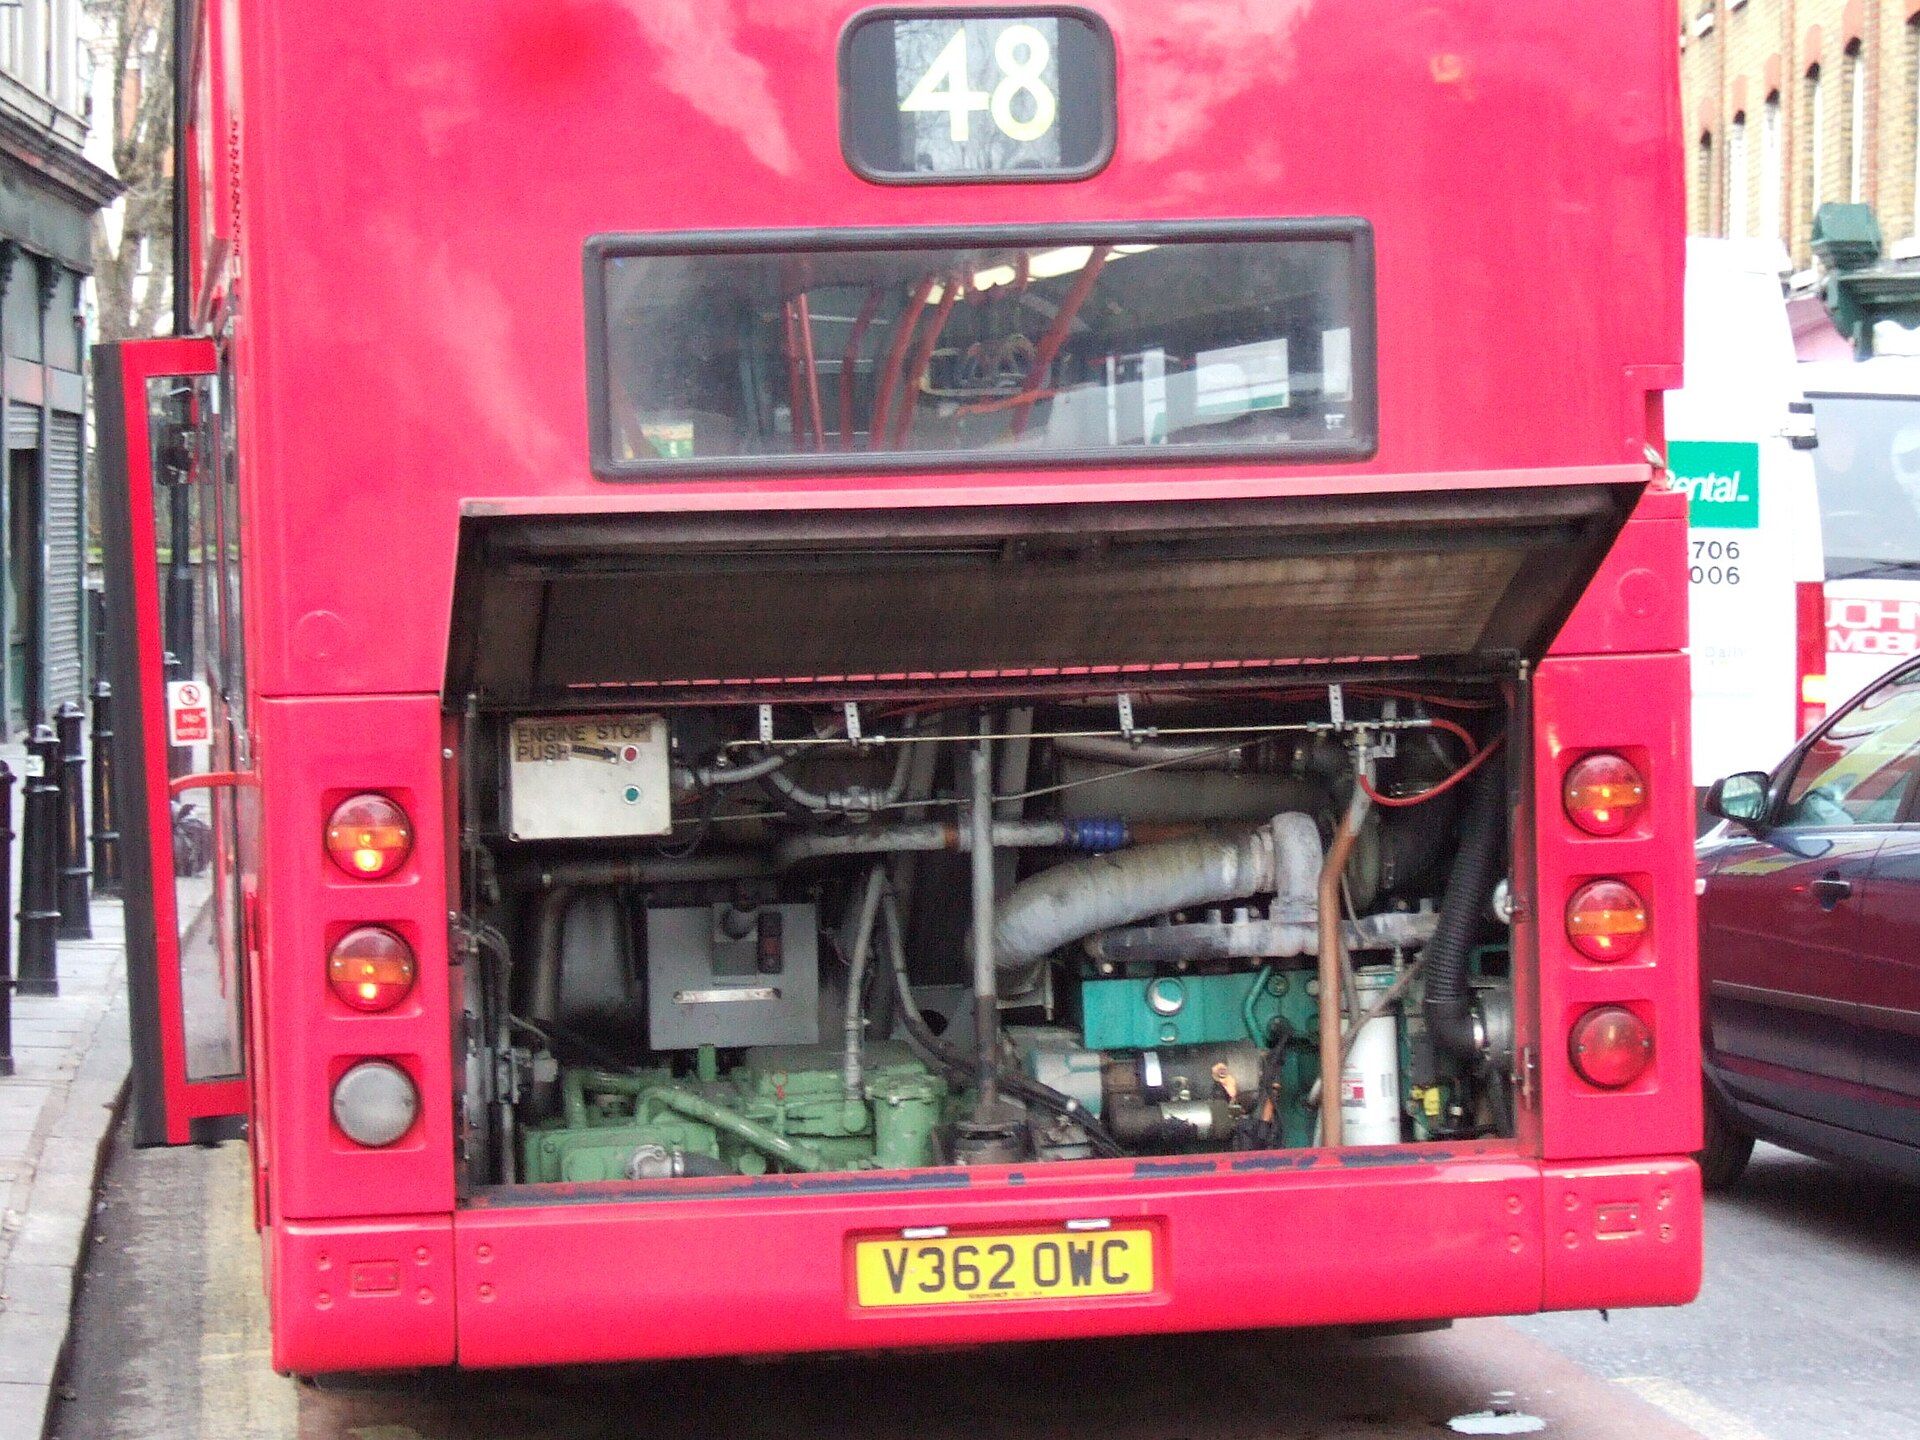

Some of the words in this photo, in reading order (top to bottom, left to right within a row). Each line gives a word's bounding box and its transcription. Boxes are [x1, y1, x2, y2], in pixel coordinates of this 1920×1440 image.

[898, 24, 1056, 142] 48
[1692, 541, 1740, 560] 706
[1689, 565, 1740, 586] 006
[517, 725, 585, 743] ENGINE
[597, 722, 649, 740] STOP
[517, 743, 569, 761] PUSH
[883, 1244, 1015, 1294] V362
[1033, 1240, 1130, 1286] OWC
